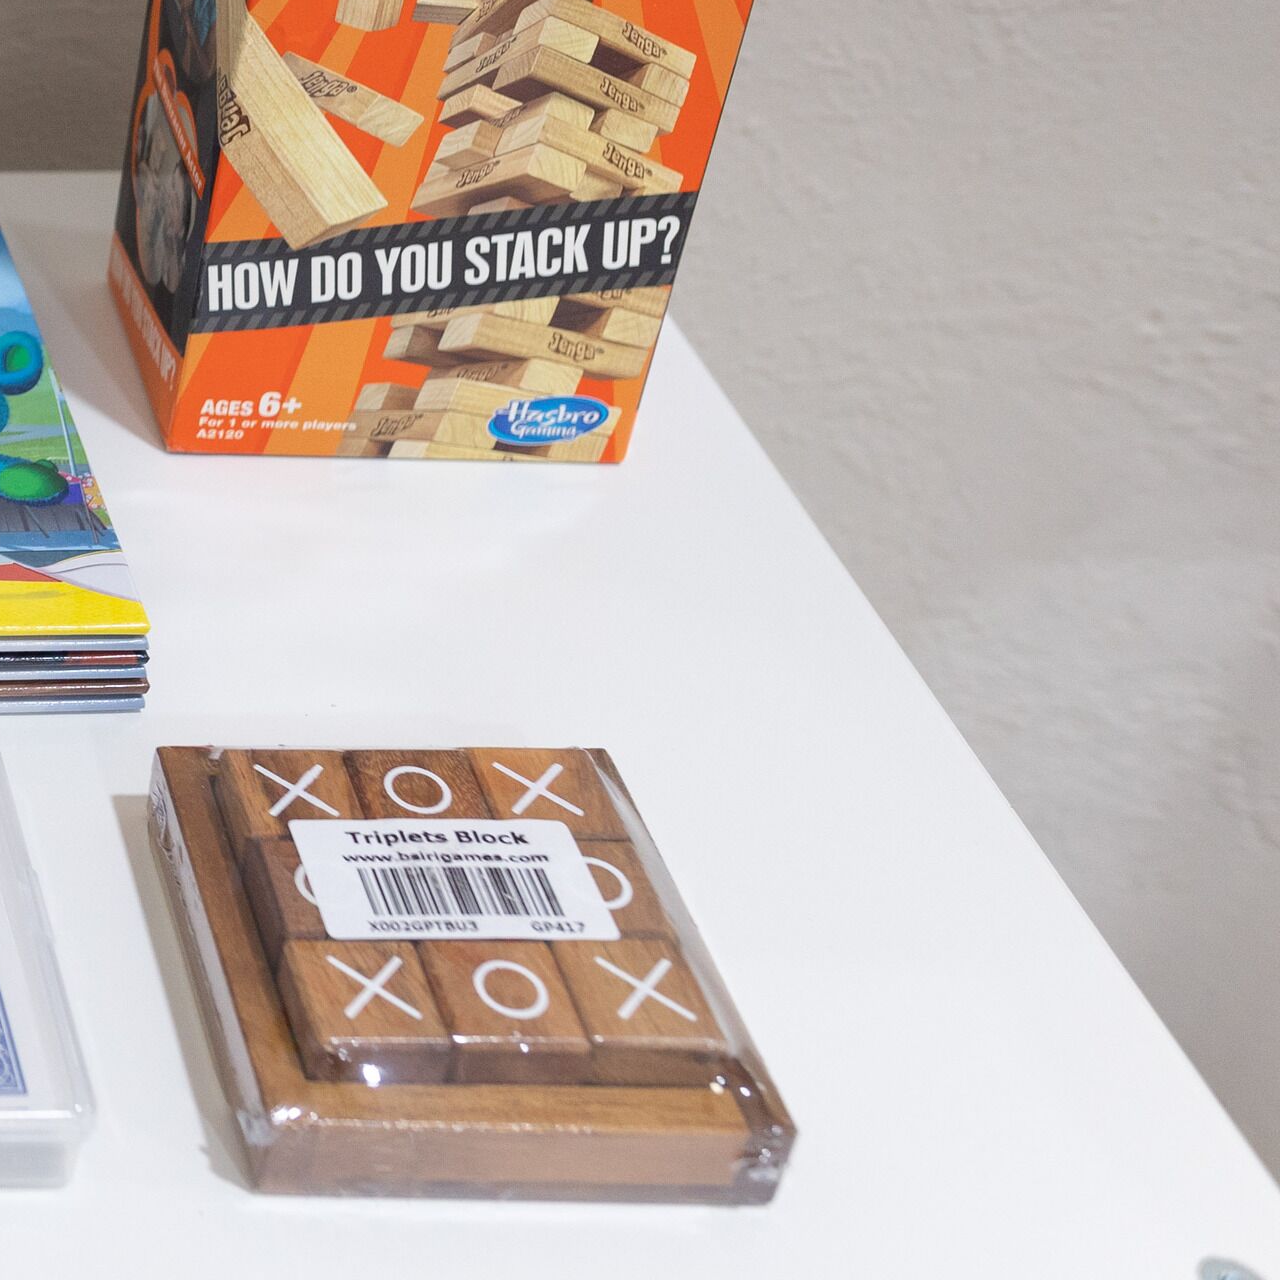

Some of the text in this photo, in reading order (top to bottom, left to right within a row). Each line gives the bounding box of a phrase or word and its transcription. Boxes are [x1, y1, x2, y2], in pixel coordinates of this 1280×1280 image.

[622, 22, 663, 58] Jenga
[600, 76, 639, 112] Jenga
[603, 143, 646, 179] Jenga
[206, 259, 299, 312] HOW
[310, 252, 363, 304] DO
[375, 243, 454, 297] YOU
[463, 224, 590, 287] STACK
[602, 214, 682, 270] UP?
[548, 332, 595, 361] Jenga
[200, 391, 302, 417] AGES 6+
[498, 400, 600, 426] Hasbro
[196, 429, 244, 439] A2120
[198, 416, 224, 427] For
[229, 418, 236, 427] 1
[261, 420, 298, 430] more
[302, 420, 357, 432] players
[345, 830, 529, 847] Triplets Block
